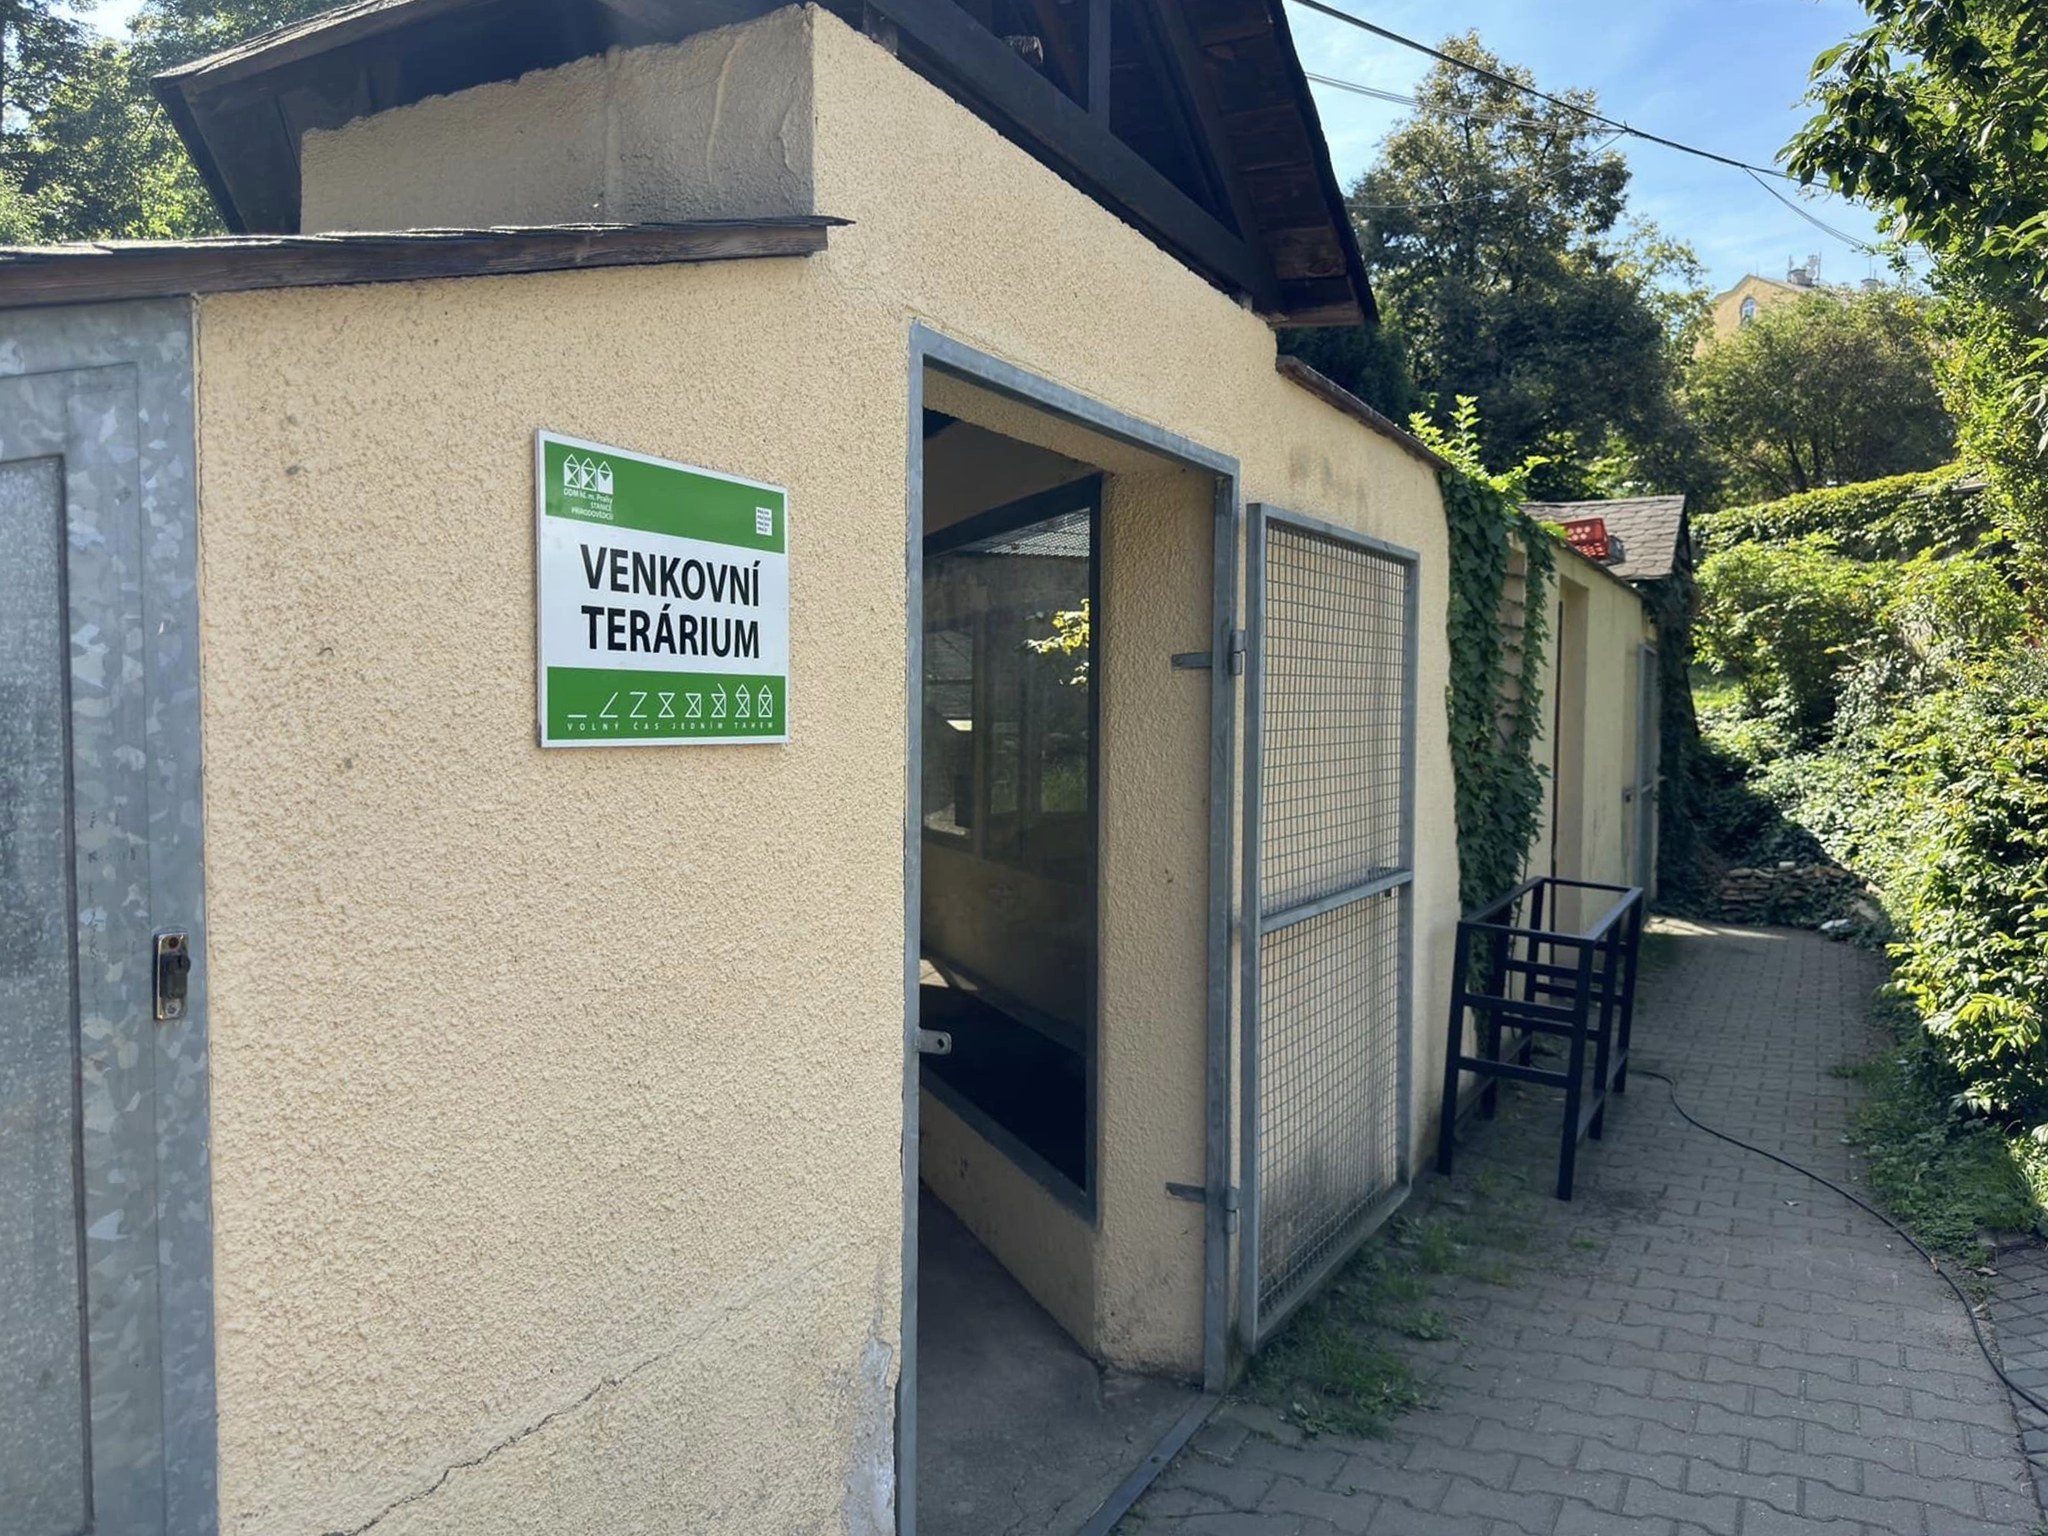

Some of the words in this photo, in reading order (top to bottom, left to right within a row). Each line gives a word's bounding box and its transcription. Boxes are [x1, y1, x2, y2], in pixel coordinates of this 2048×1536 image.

[580, 544, 761, 607] VENKOVNÍ
[581, 603, 760, 659] TERÁRIUM
[633, 721, 659, 731] ČAS
